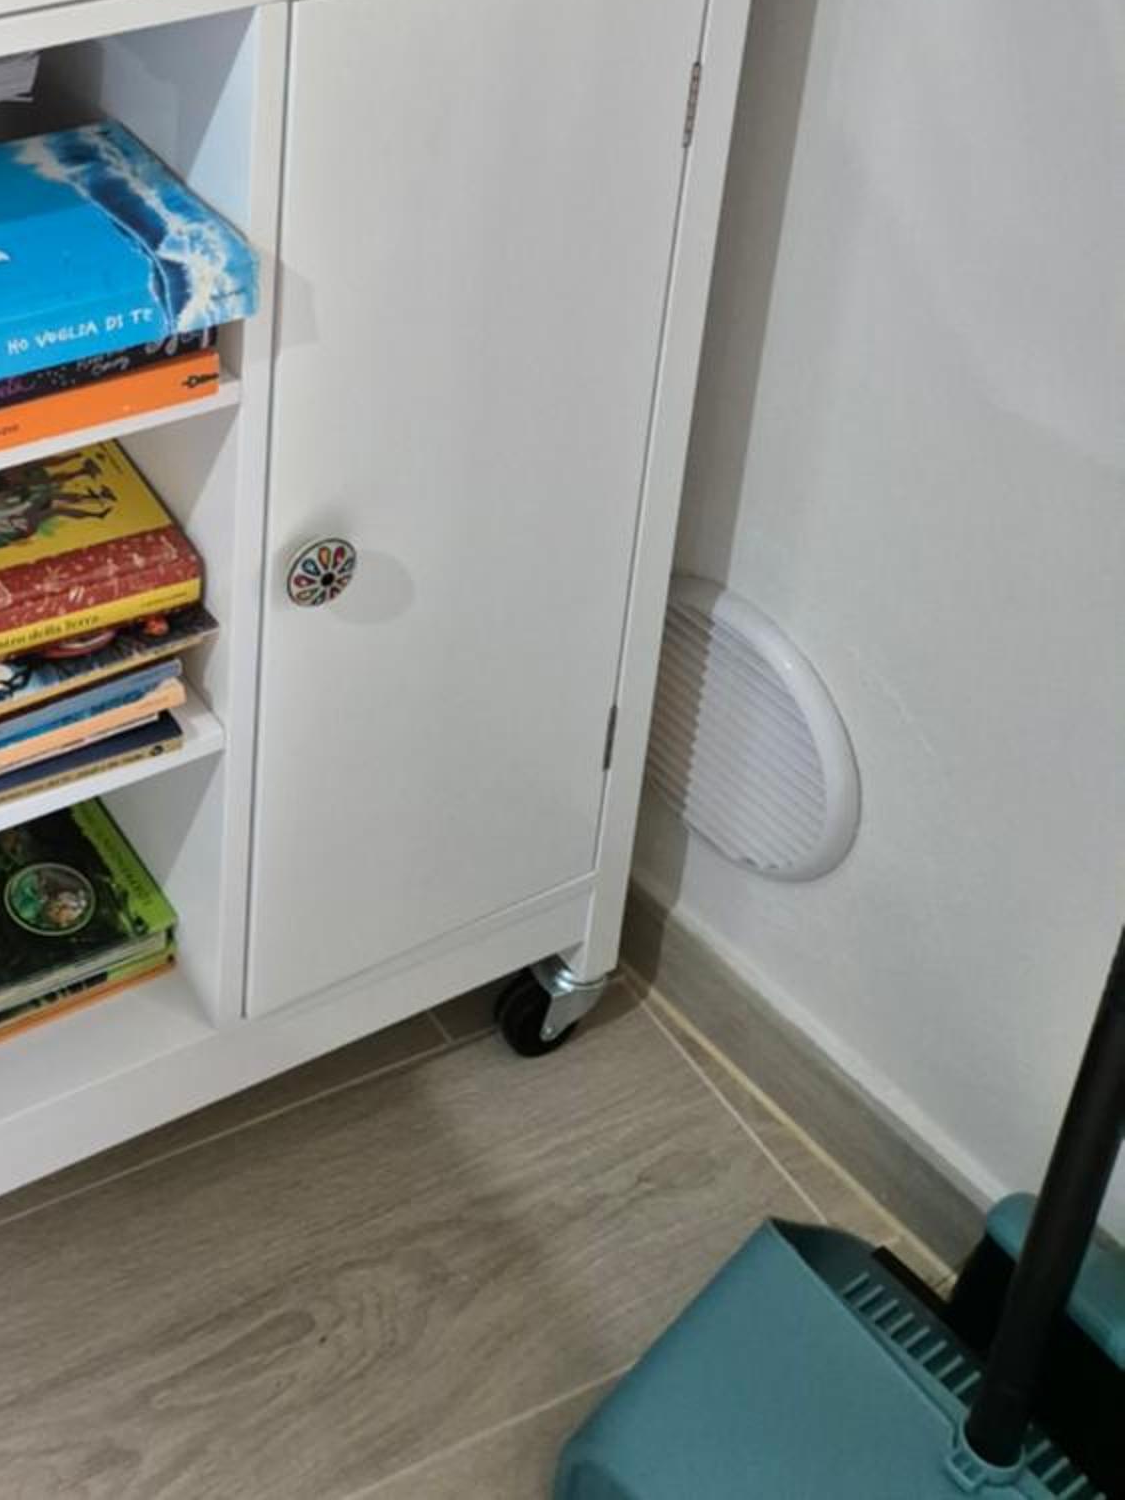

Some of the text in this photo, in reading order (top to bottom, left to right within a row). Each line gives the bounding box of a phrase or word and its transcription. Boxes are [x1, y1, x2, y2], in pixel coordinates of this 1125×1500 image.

[6, 338, 29, 356] HO
[35, 320, 99, 349] VOGLIA
[104, 313, 124, 332] DI
[131, 307, 154, 324] TE
